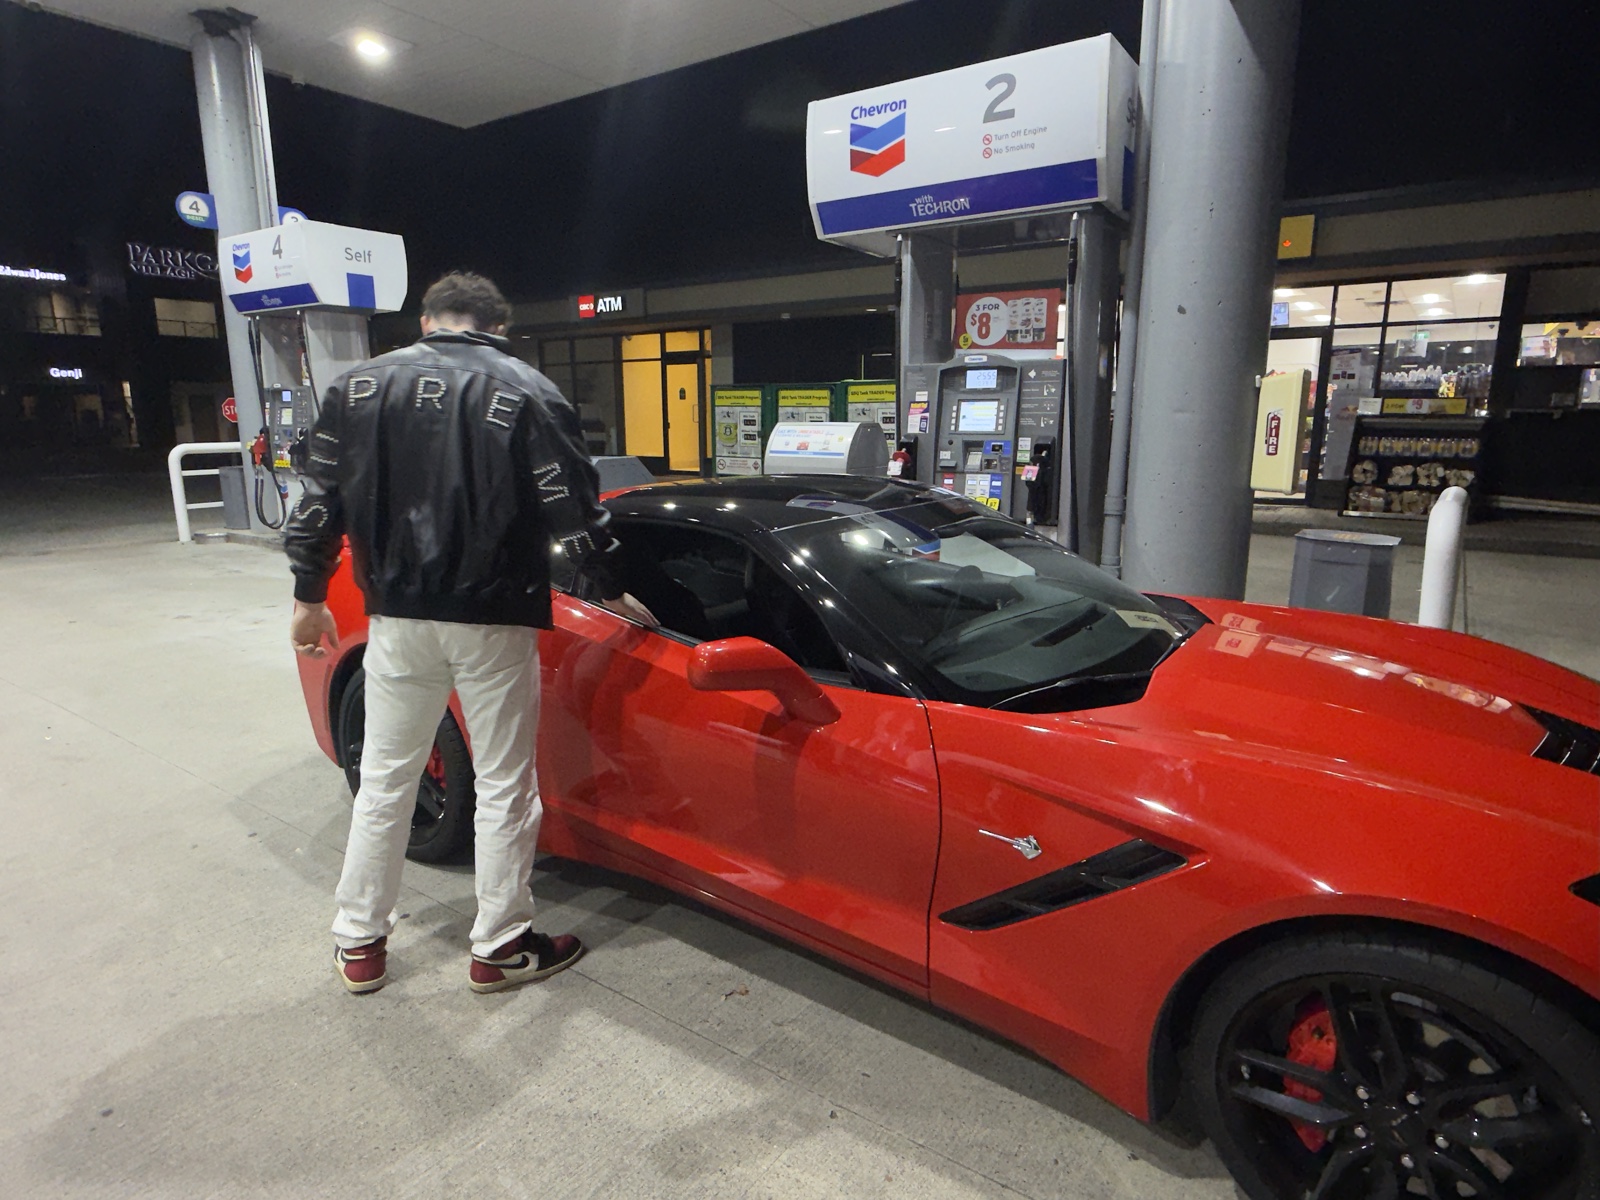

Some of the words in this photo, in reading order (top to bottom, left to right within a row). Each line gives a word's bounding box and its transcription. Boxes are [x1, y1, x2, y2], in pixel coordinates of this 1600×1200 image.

[982, 73, 1017, 124] 2
[851, 99, 907, 120] Chevron
[994, 133, 1010, 142] Turn
[1011, 130, 1022, 139] Off
[1023, 126, 1048, 136] Engine
[1005, 142, 1035, 154] Smoking
[189, 201, 200, 213] 4
[909, 197, 970, 217] TECHRON
[915, 194, 934, 204] with
[186, 214, 205, 222] DIESEL
[272, 234, 283, 259] 4
[127, 243, 219, 272] PARKG
[344, 247, 372, 263] Self
[130, 263, 196, 280] VILLAGE
[597, 296, 623, 313] ATM
[976, 304, 980, 312] 3
[983, 303, 1000, 311] FOR
[50, 368, 82, 380] Genji
[224, 406, 237, 415] ST
[1268, 420, 1279, 454] FIRE
